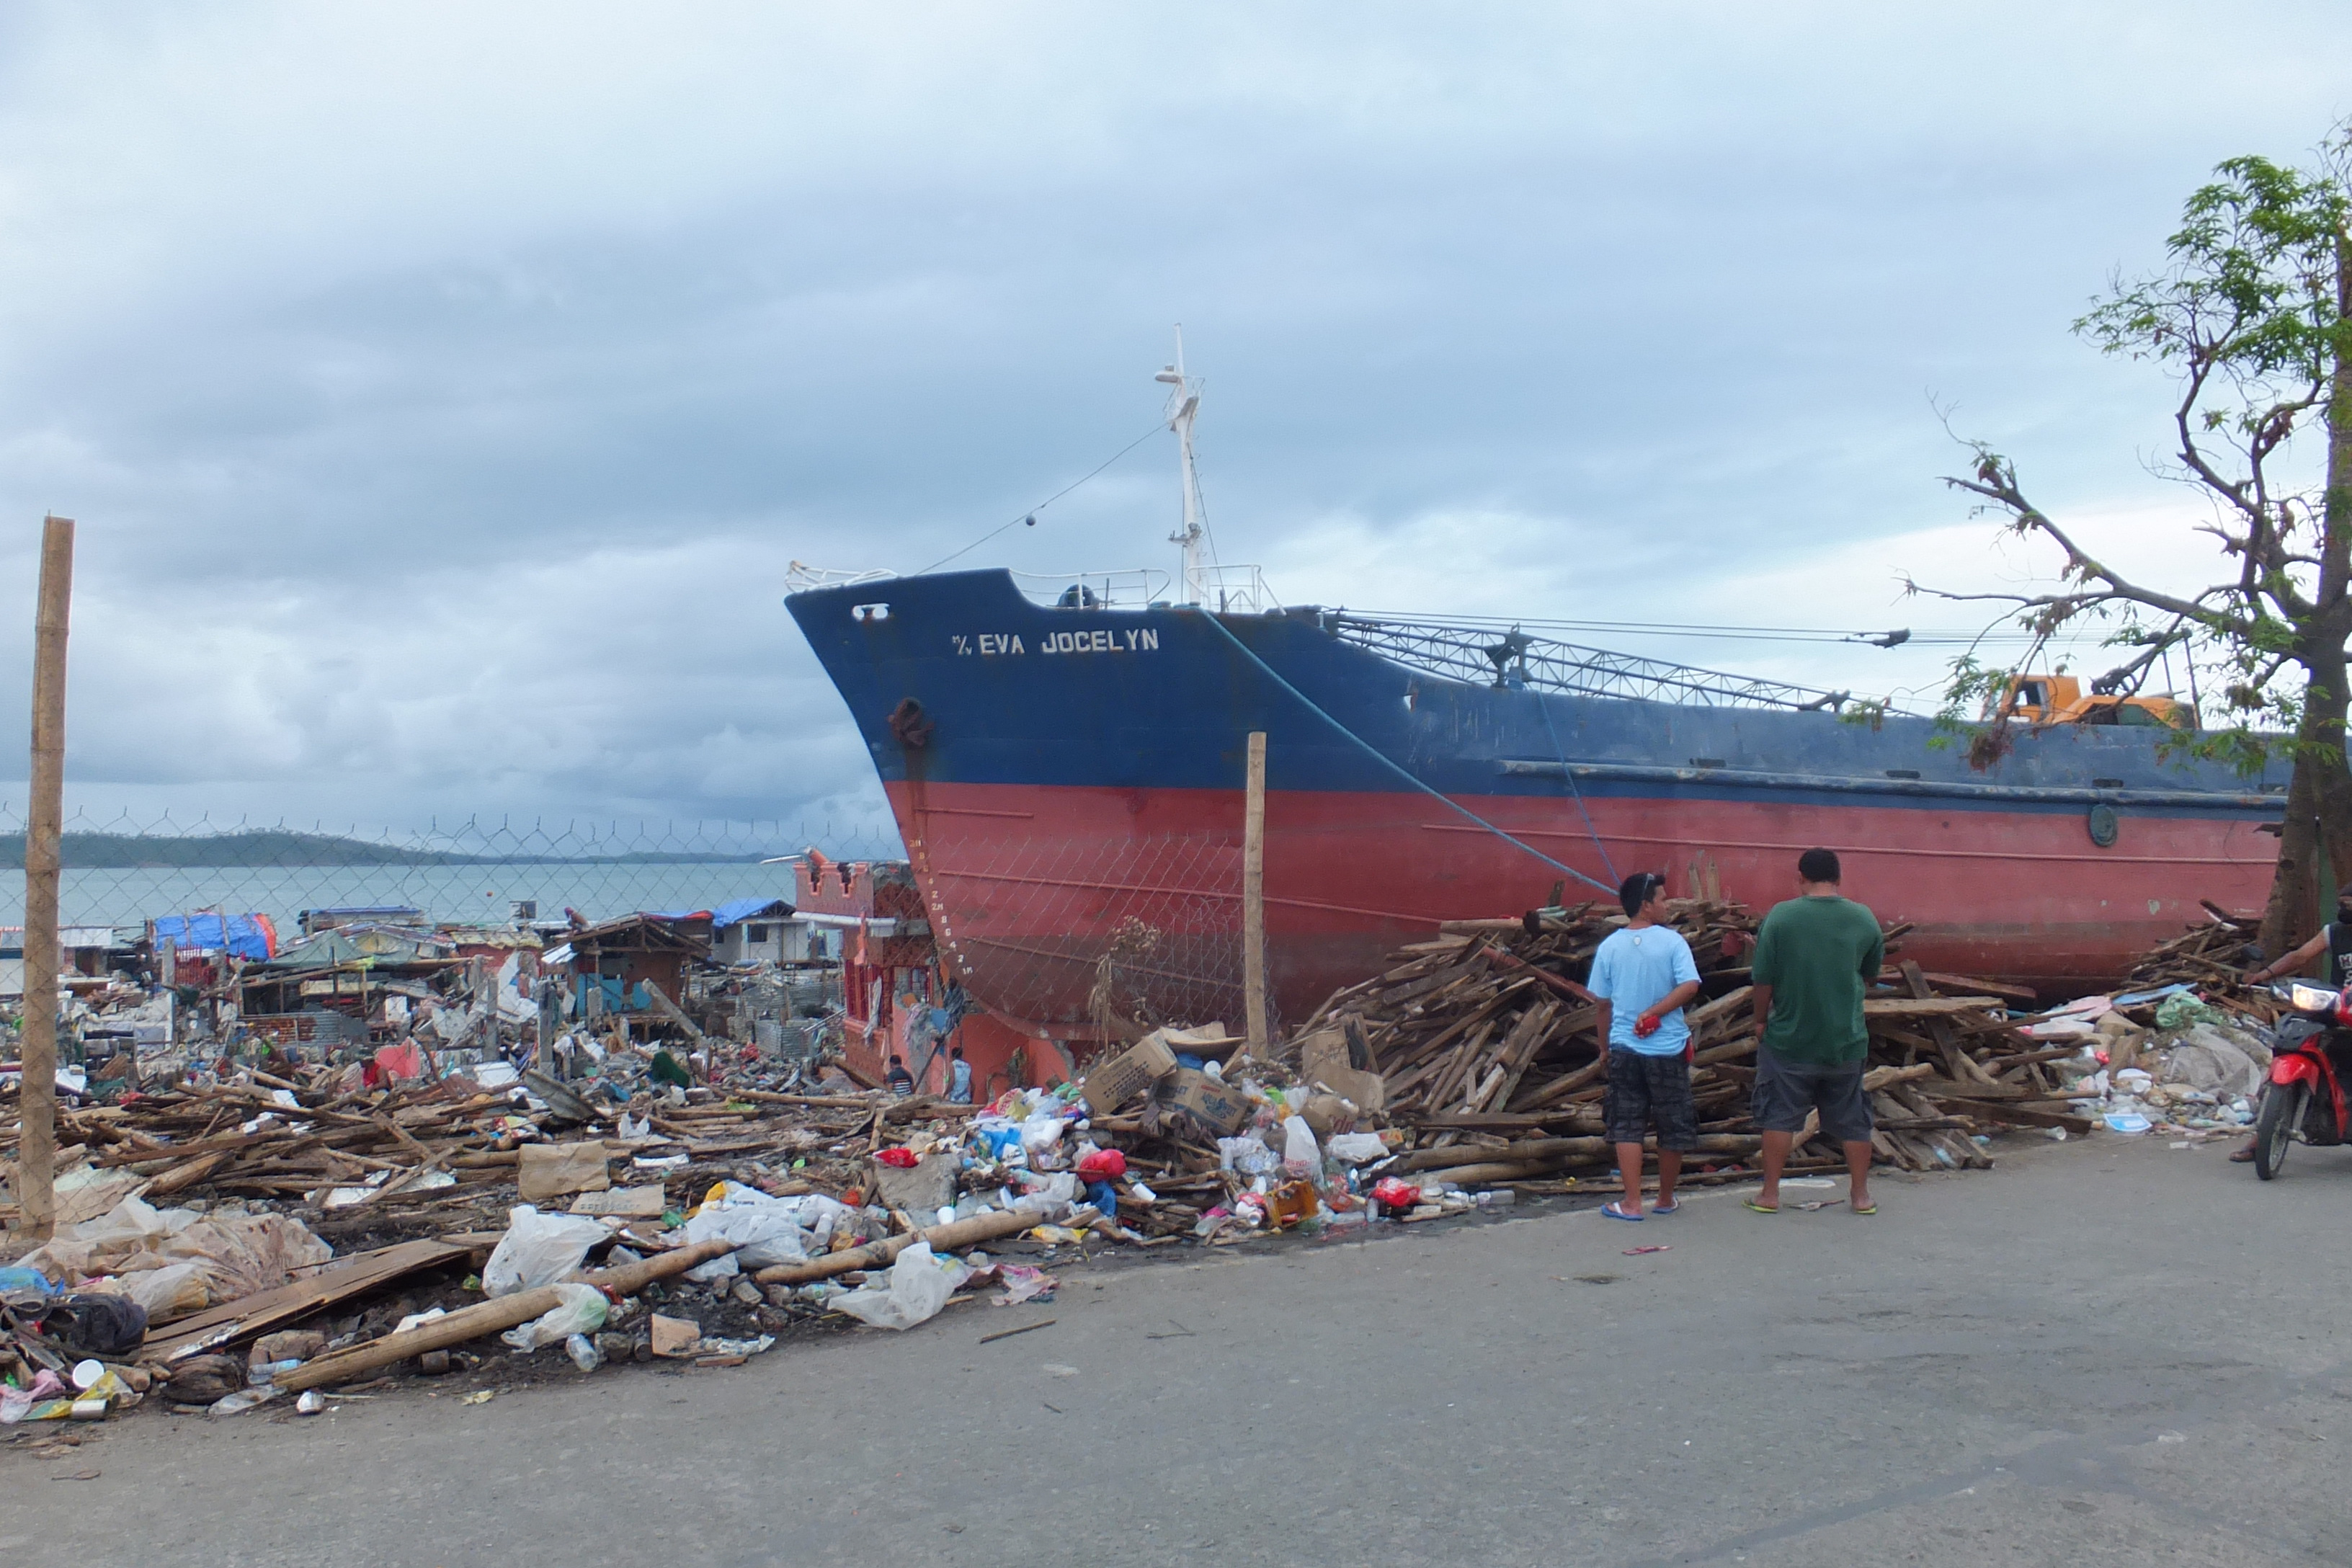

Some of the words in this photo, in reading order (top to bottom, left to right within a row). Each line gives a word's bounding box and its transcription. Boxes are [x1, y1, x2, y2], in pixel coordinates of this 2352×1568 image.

[979, 633, 1025, 654] EVA
[1041, 628, 1159, 654] JOCELYN
[932, 890, 938, 899] 2
[958, 954, 964, 963] 2
